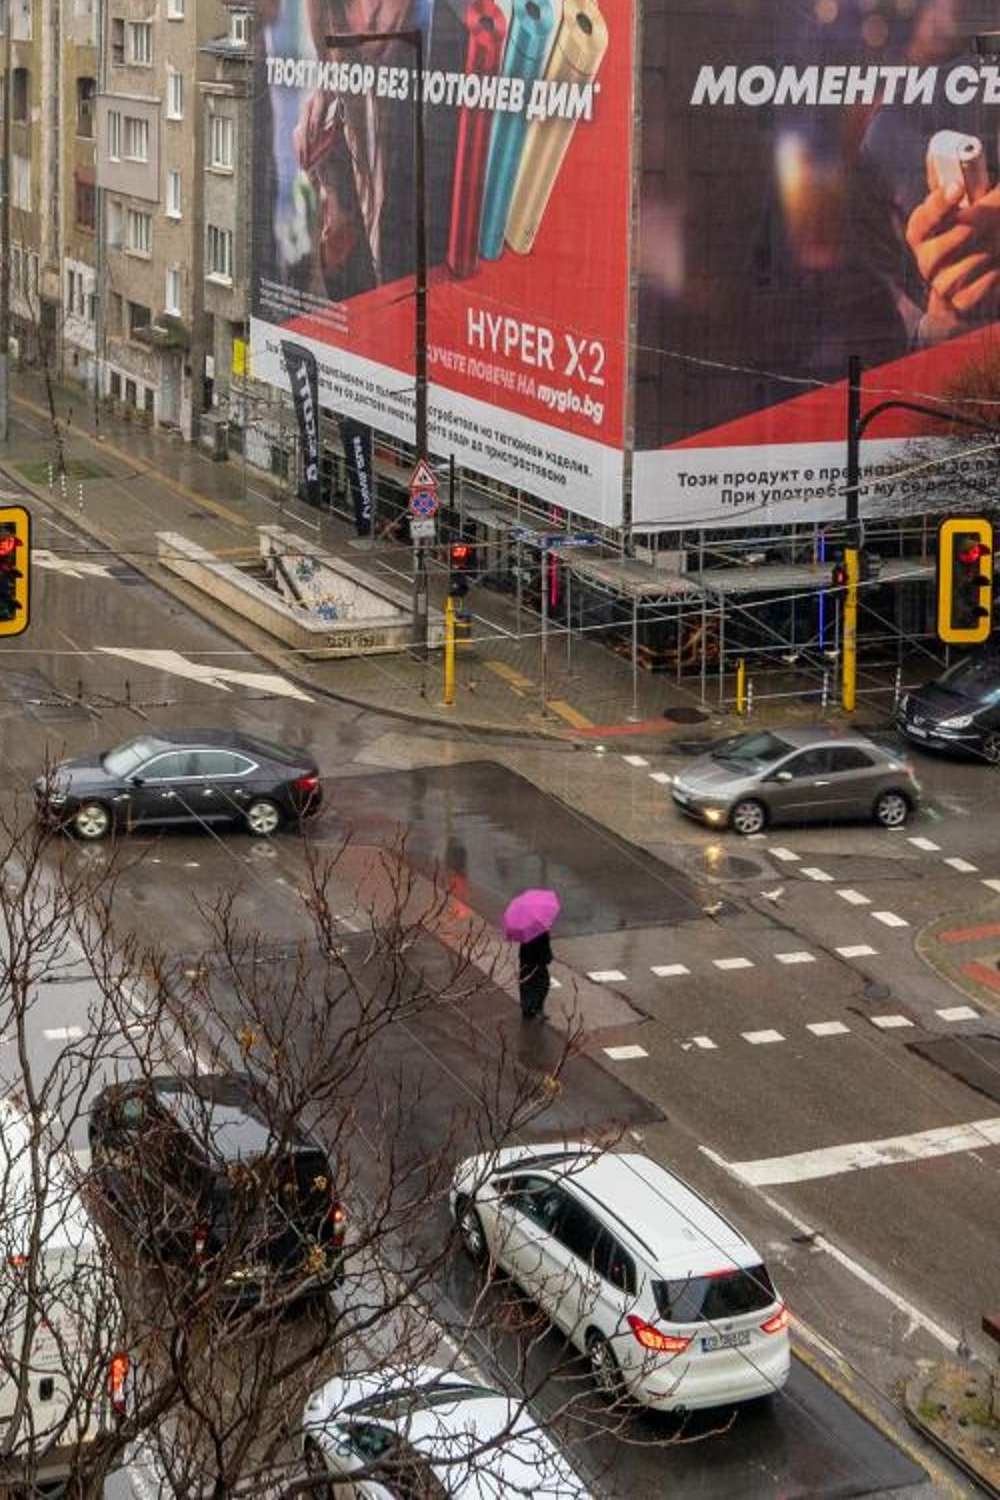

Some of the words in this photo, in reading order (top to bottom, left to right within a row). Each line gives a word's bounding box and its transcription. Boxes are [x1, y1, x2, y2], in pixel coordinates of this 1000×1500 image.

[266, 57, 316, 88] ТВОЯТ
[318, 61, 375, 95] ИЗБОР
[377, 67, 409, 100] БЕЗ
[690, 65, 938, 106] МОМЕНТИ
[467, 307, 554, 371] HYPER
[564, 334, 605, 386] X2
[468, 356, 516, 390] ПОВЕЧЕ
[517, 372, 535, 396] НА
[537, 384, 604, 424] myglo.bg
[678, 472, 719, 488] Този
[723, 467, 799, 488] продукт
[804, 469, 815, 481] е
[721, 489, 755, 507] При
[874, 483, 897, 497] му
